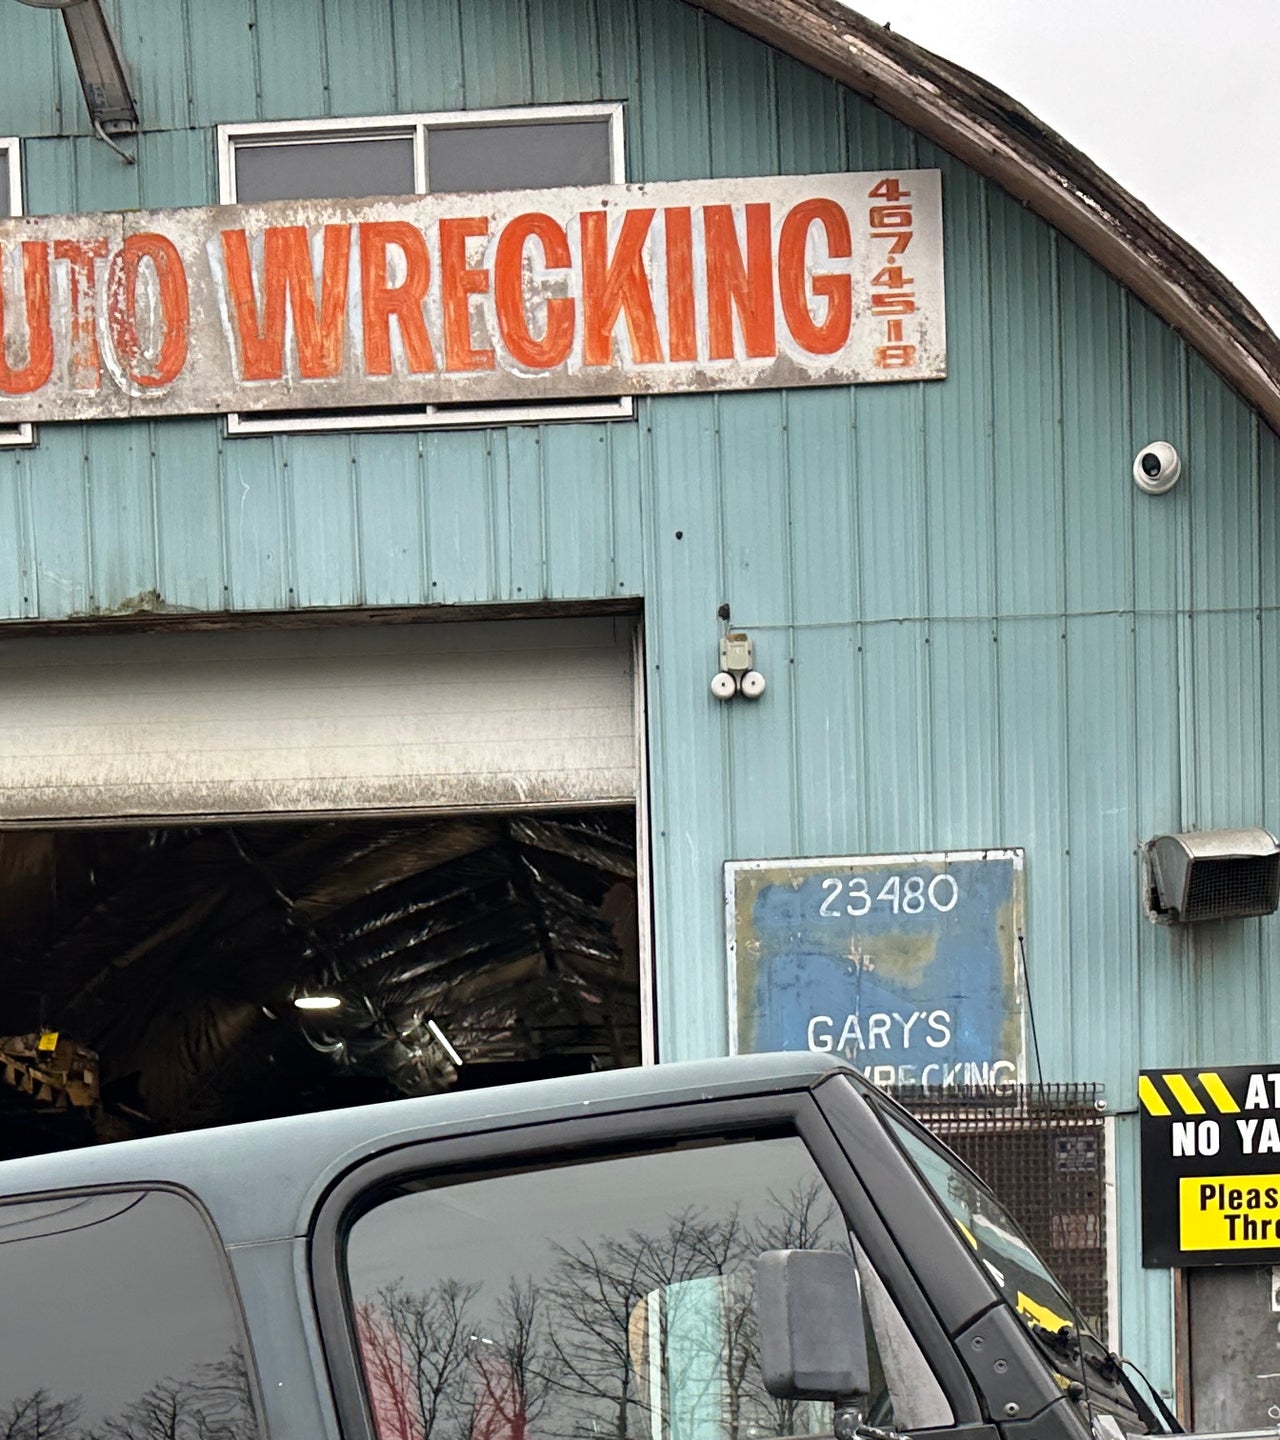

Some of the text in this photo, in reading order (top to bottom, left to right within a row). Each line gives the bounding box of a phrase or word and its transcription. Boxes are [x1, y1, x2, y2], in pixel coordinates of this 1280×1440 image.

[220, 198, 853, 381] WRECKING
[820, 873, 959, 918] 23480
[807, 1009, 952, 1053] GARY'S
[864, 1060, 1016, 1096] RECKING
[1172, 1121, 1220, 1157] NO
